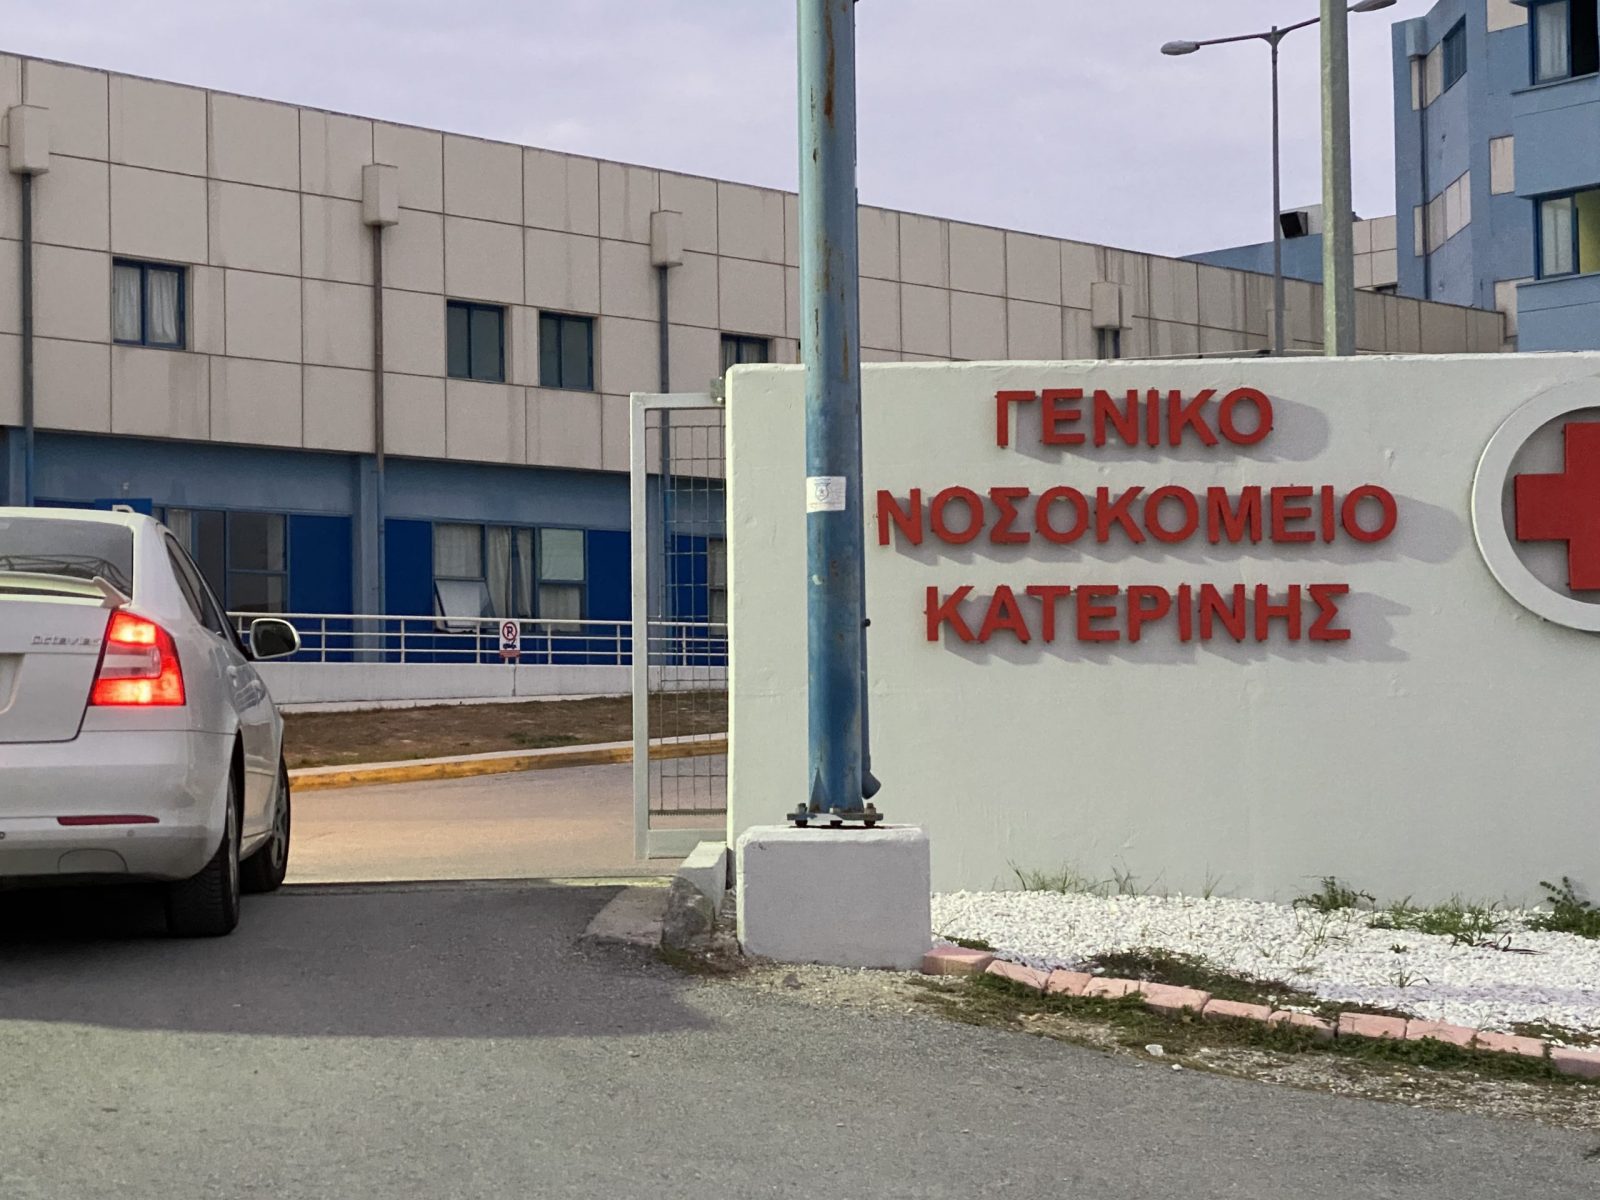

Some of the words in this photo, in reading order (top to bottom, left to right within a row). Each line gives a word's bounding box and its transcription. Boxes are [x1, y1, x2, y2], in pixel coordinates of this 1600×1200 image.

[995, 387, 1274, 447] ΓΕΝΙΚΟ
[876, 484, 1398, 546] ΝΟΣΟΚΟΜΕΙΟ
[925, 583, 1352, 643] ΚΑΤΕΡΙΝΗΣ
